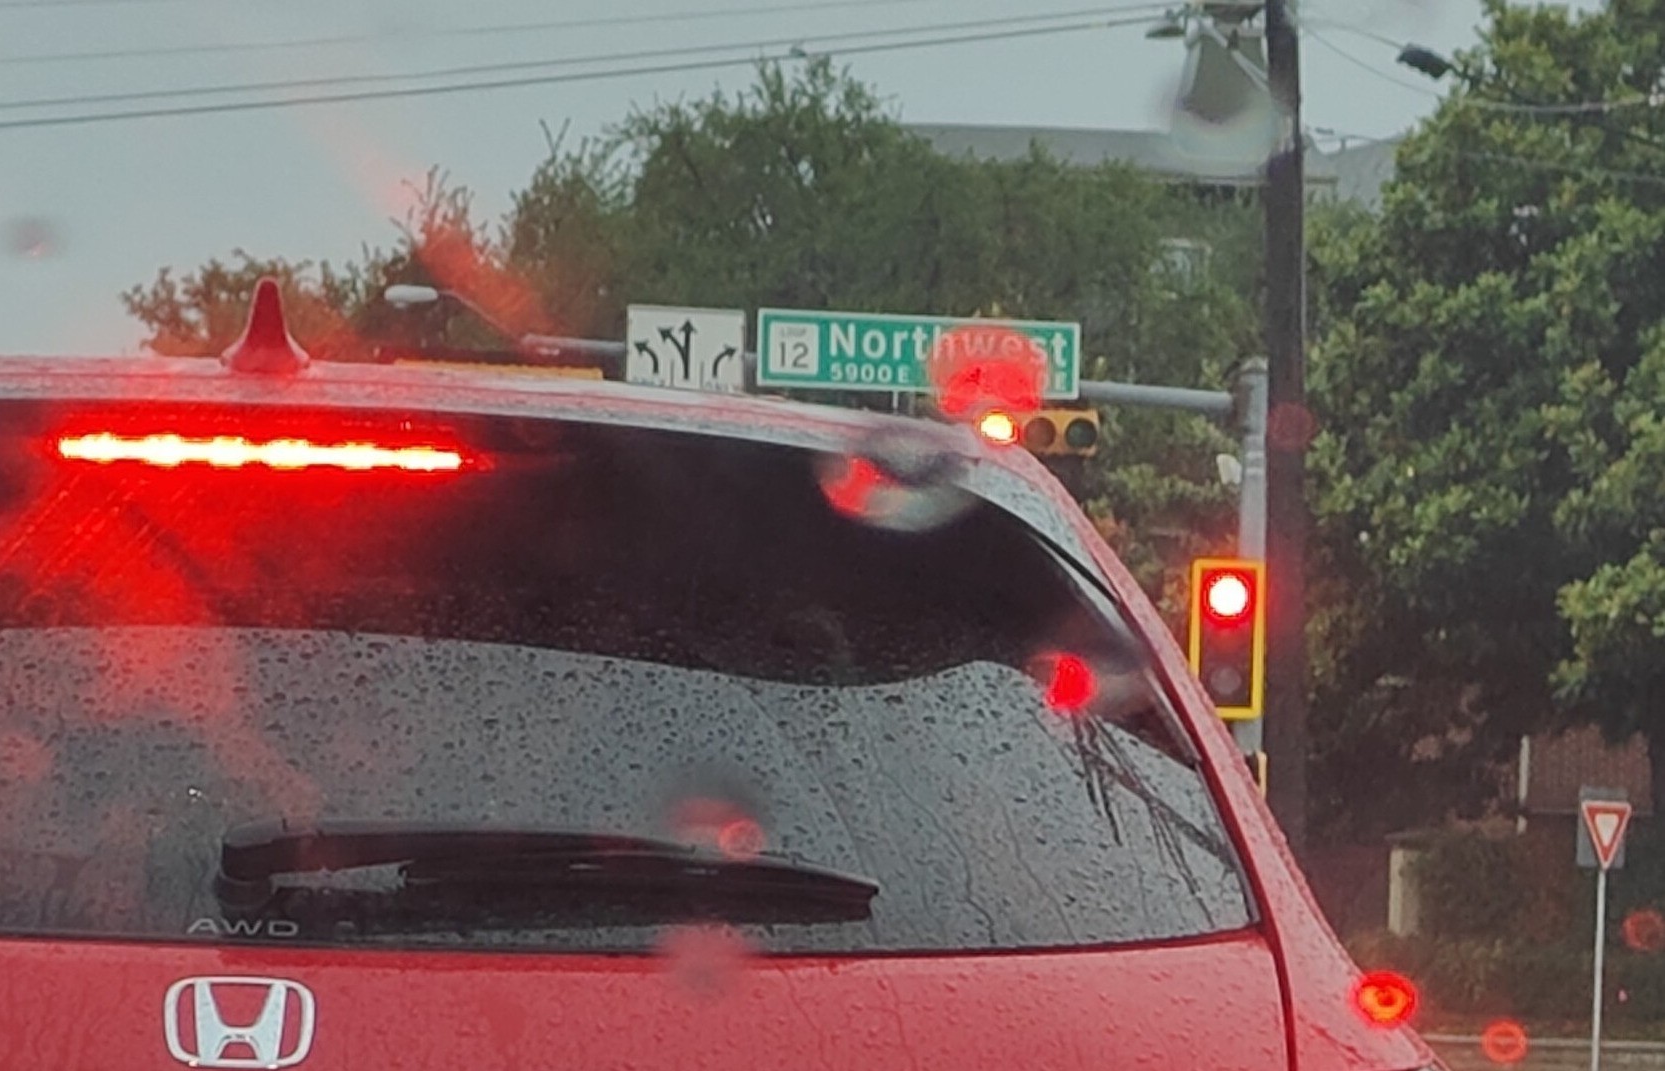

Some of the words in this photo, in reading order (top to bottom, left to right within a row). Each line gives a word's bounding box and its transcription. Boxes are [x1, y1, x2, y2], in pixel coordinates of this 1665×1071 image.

[779, 341, 809, 369] 12
[828, 322, 1069, 368] Northwest
[897, 365, 911, 384] E
[186, 917, 299, 937] AWD
